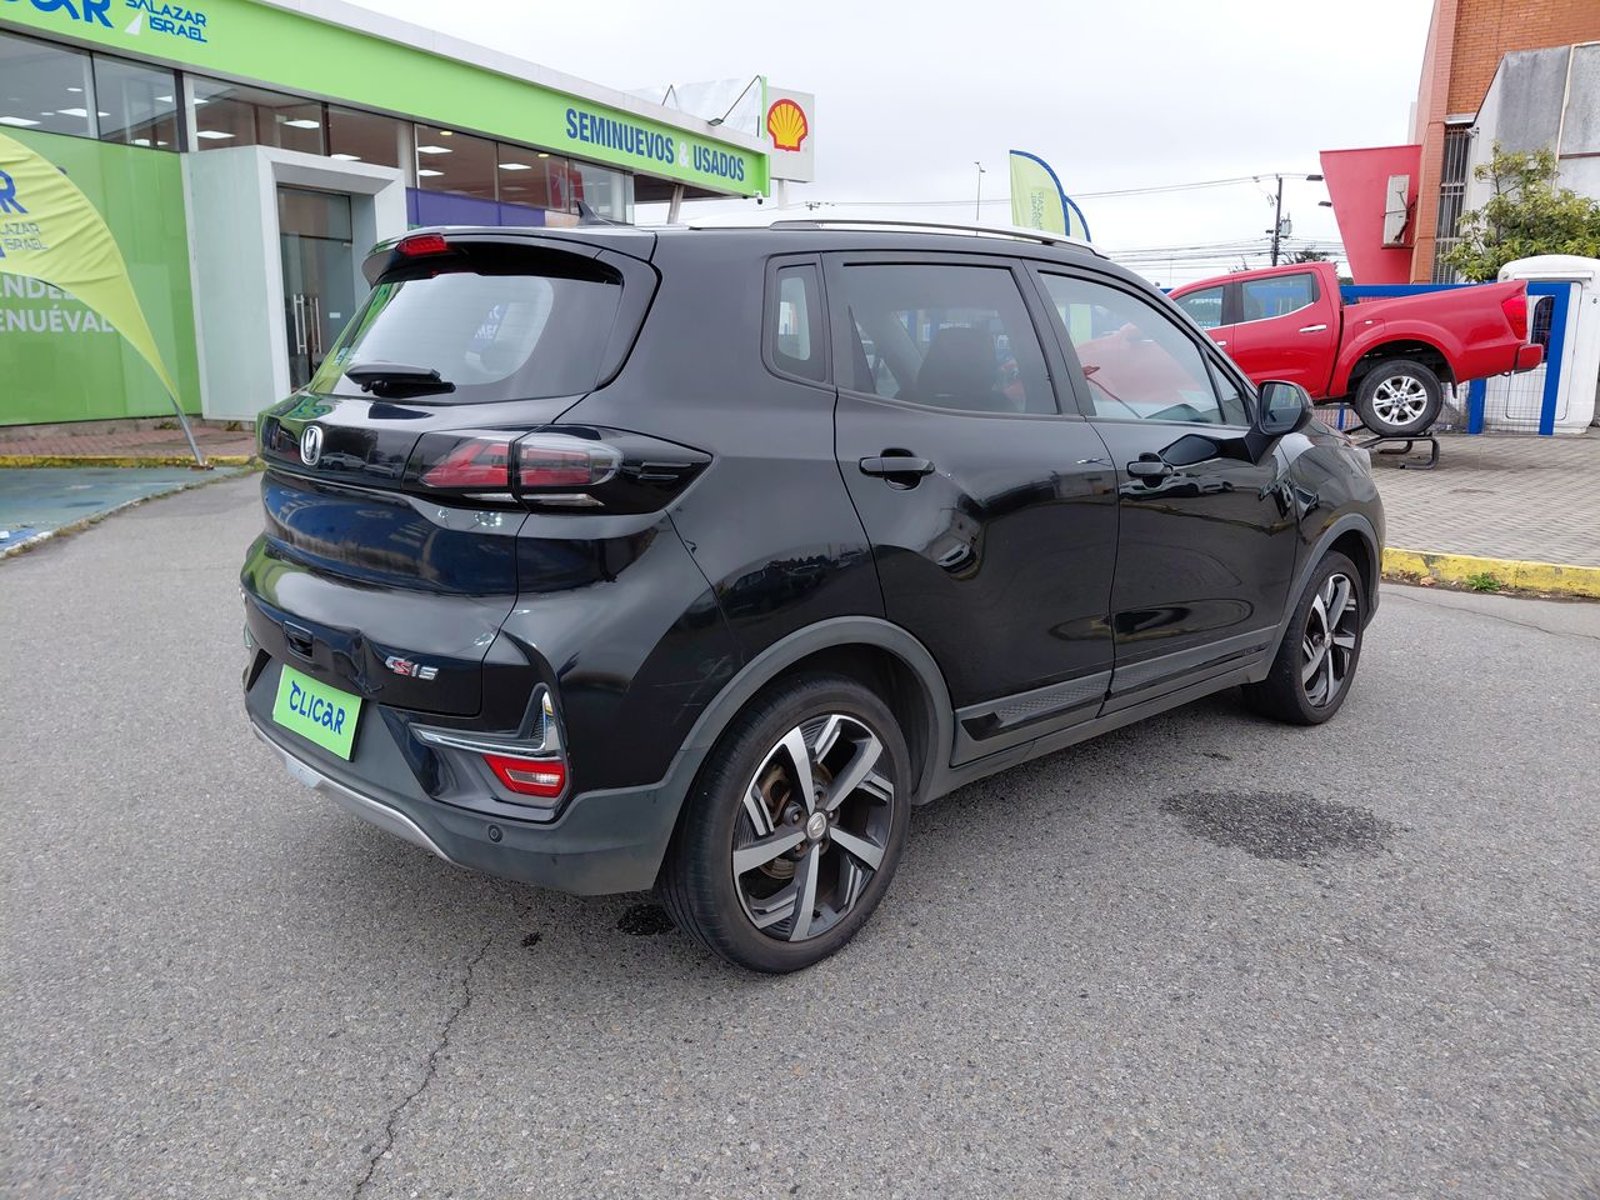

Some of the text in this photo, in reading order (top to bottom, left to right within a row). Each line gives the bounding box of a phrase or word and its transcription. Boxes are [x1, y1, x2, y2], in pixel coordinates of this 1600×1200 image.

[126, 0, 206, 27] SALAZAR
[149, 15, 208, 43] ISRAEL
[566, 108, 745, 182] SEMINUEVOS & USADOS
